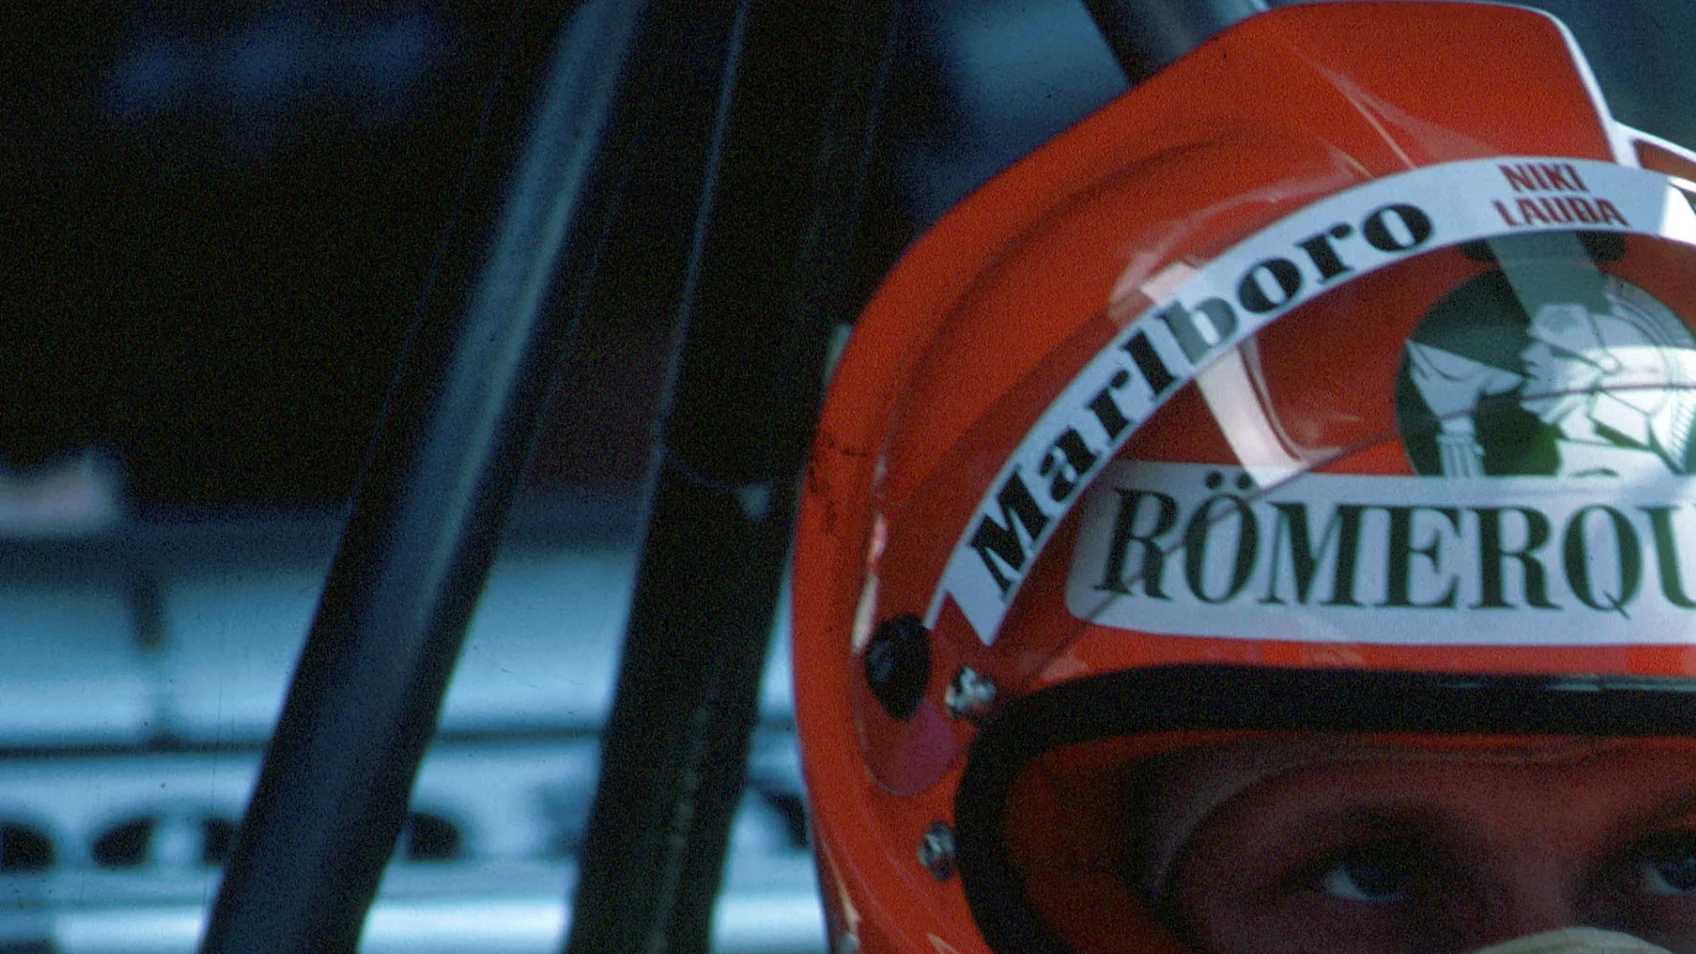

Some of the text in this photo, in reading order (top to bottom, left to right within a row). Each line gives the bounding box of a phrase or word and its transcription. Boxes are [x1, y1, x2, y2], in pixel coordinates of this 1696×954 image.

[1498, 163, 1590, 193] NIKI
[1491, 197, 1633, 228] LAUDA
[967, 202, 1435, 599] Marlboro
